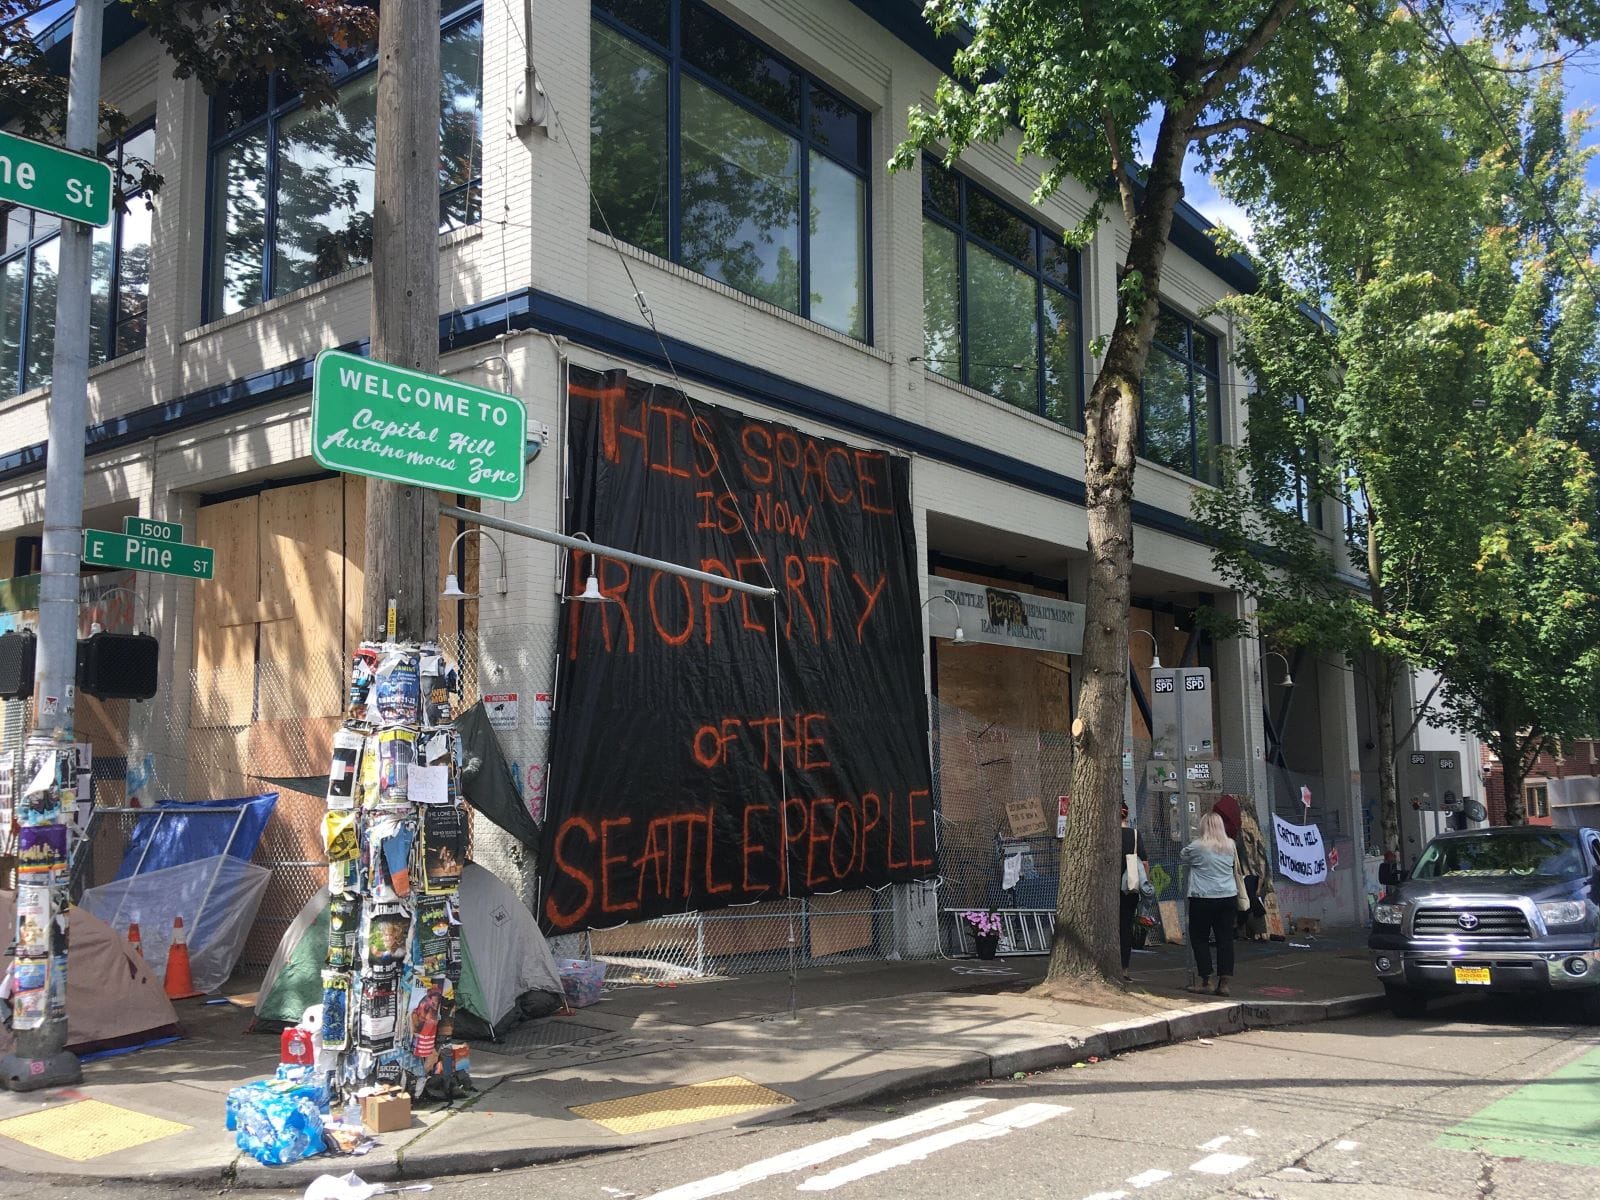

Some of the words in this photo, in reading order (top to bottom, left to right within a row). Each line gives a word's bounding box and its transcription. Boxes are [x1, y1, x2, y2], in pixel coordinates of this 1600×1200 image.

[65, 178, 94, 208] St
[339, 367, 470, 417] WELCOME
[478, 402, 508, 426] TO
[322, 428, 458, 471] Autonomous
[468, 457, 519, 484] Zone
[352, 408, 439, 443] Capitol
[448, 432, 497, 457] Hill
[568, 383, 719, 478] THIS
[741, 424, 895, 515] SPACE
[140, 523, 171, 539] 1500
[696, 491, 743, 534] IS
[754, 493, 814, 540] NOW
[93, 541, 104, 558] E
[126, 538, 172, 568] Pine
[193, 560, 209, 573] ST
[568, 546, 887, 661] PROPERTY
[1155, 682, 1173, 691] SPD
[1186, 680, 1204, 690] SPD
[693, 719, 742, 769] OF
[749, 713, 831, 771] THE
[546, 804, 770, 928] SEATTLE
[779, 789, 933, 895] PEOPLE
